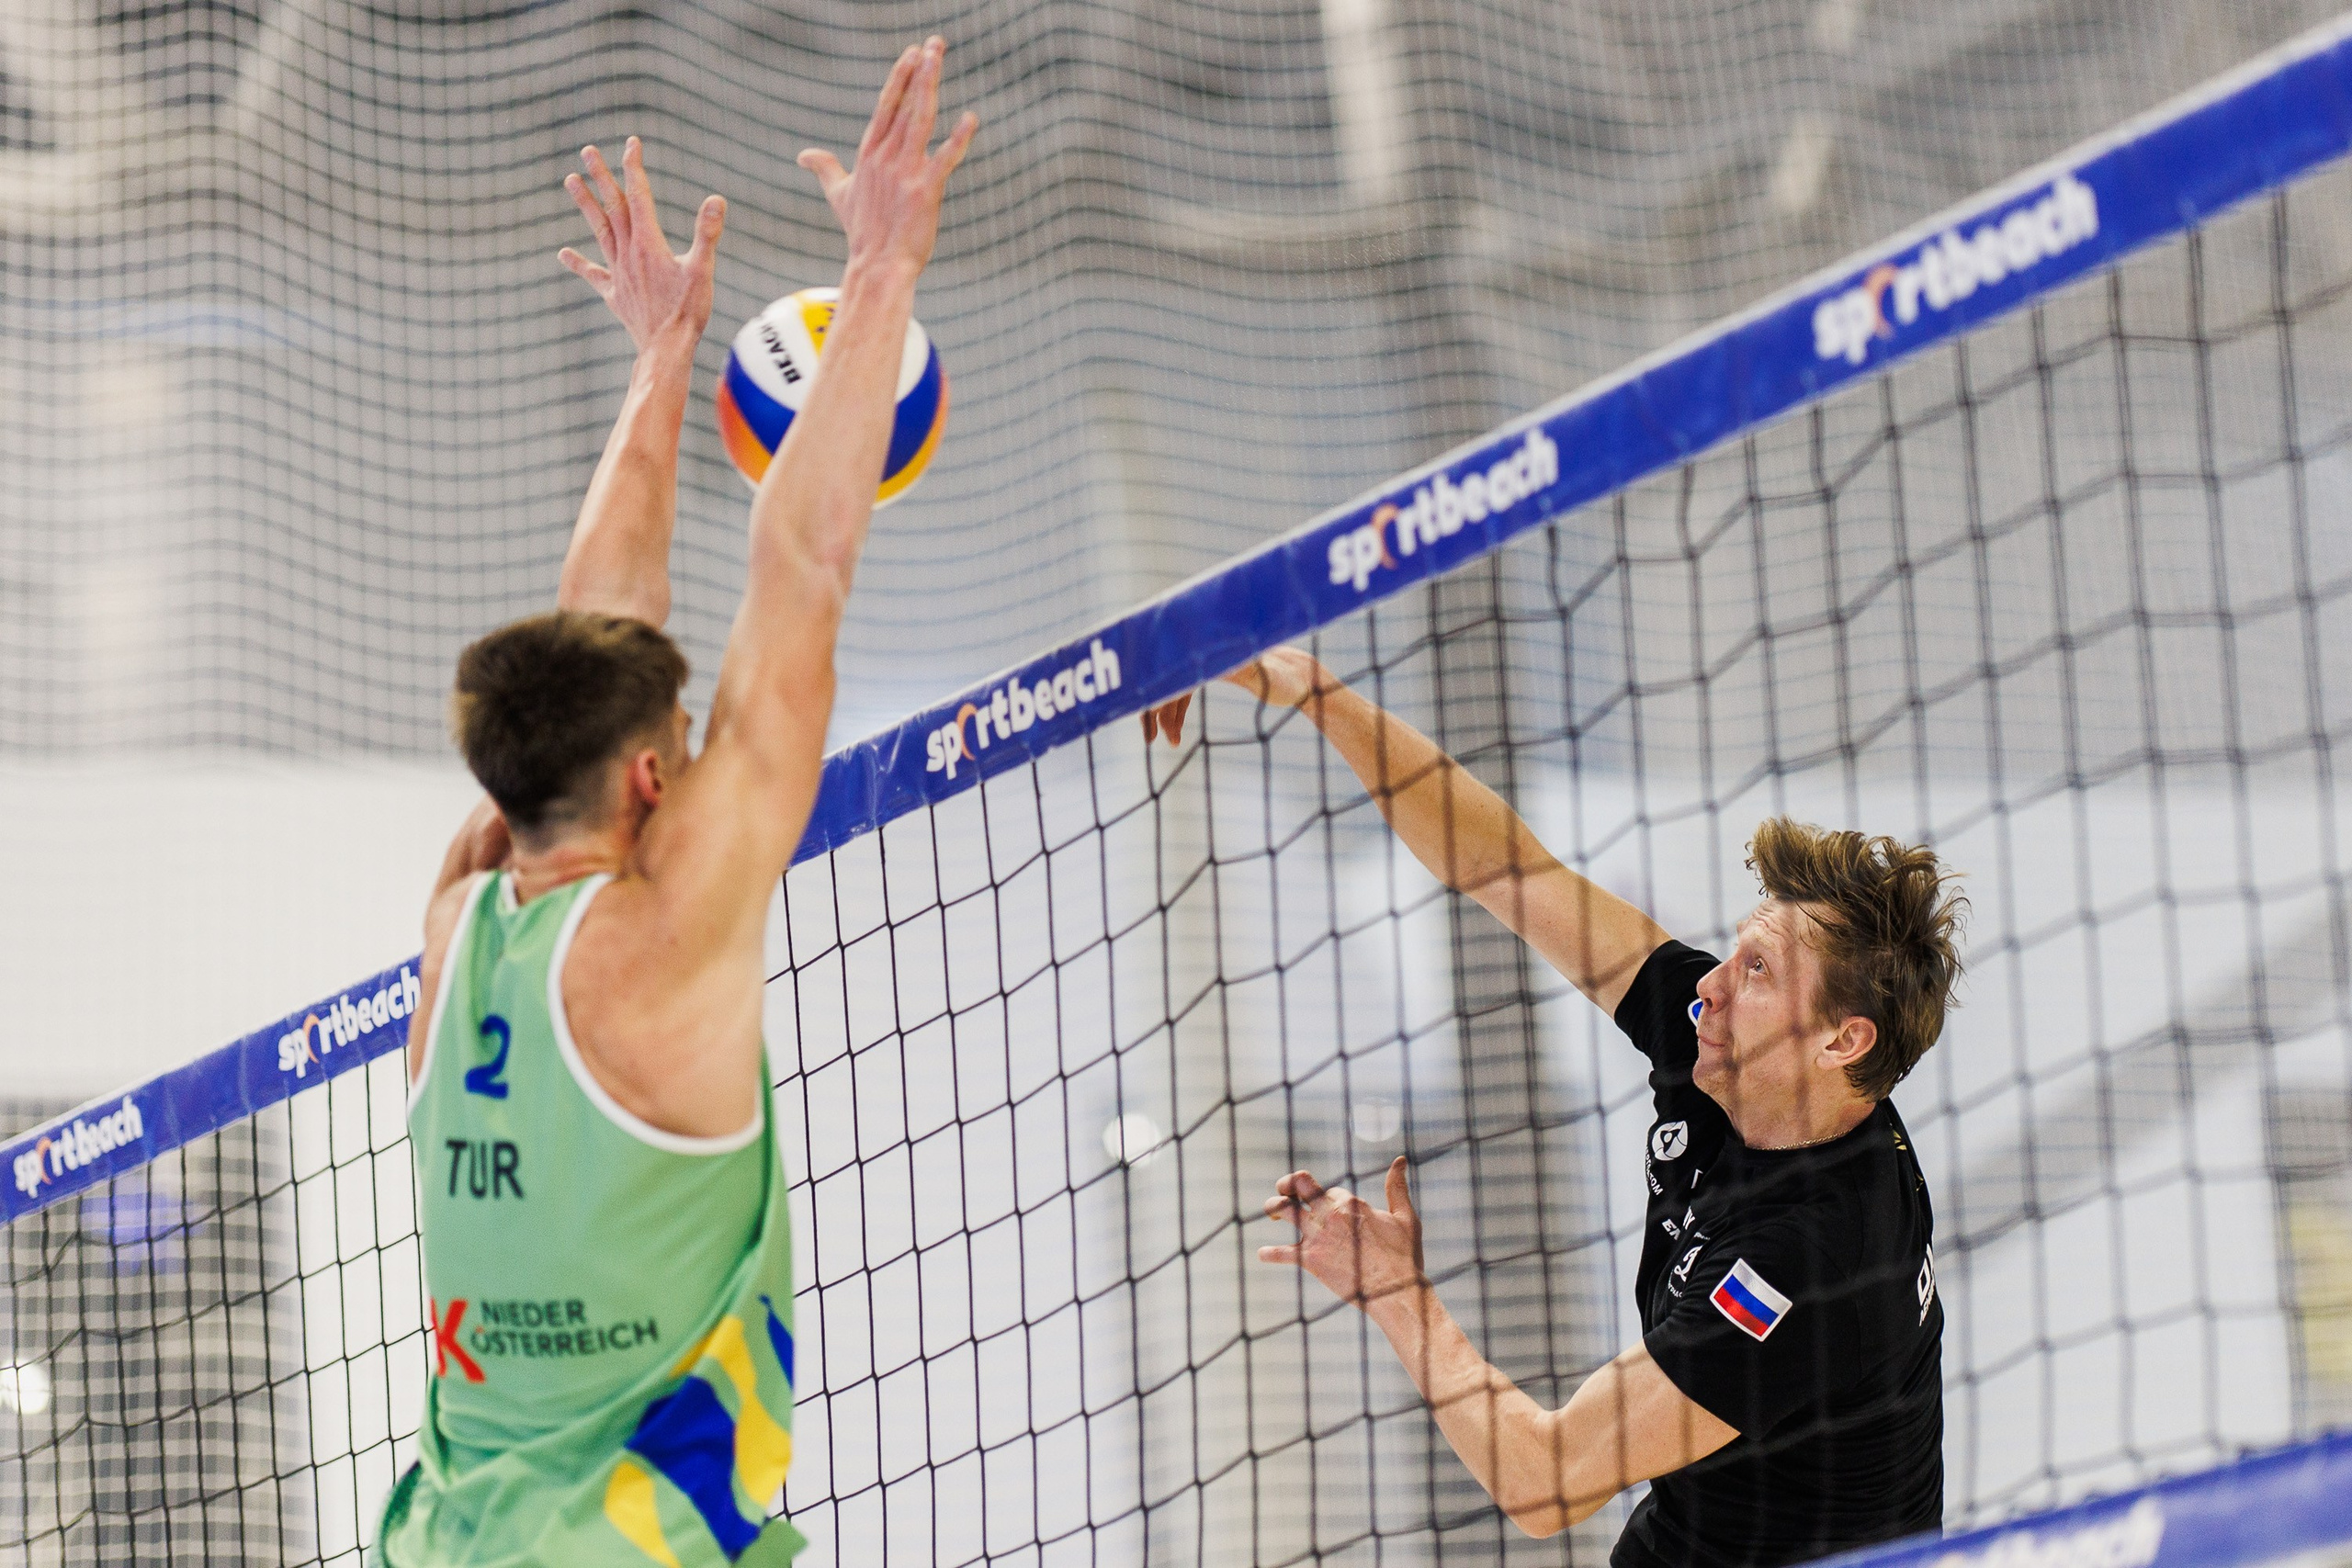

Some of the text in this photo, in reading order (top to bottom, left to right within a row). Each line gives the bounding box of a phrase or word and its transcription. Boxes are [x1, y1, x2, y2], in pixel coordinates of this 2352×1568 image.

[1329, 426, 1559, 592] sportbeach
[926, 638, 1121, 780] sportbeach
[278, 966, 421, 1078] sportbeach
[465, 1014, 512, 1100] 2
[13, 1094, 144, 1199] sportbeach
[446, 1139, 524, 1200] TUR
[481, 1299, 586, 1327] NIEDER
